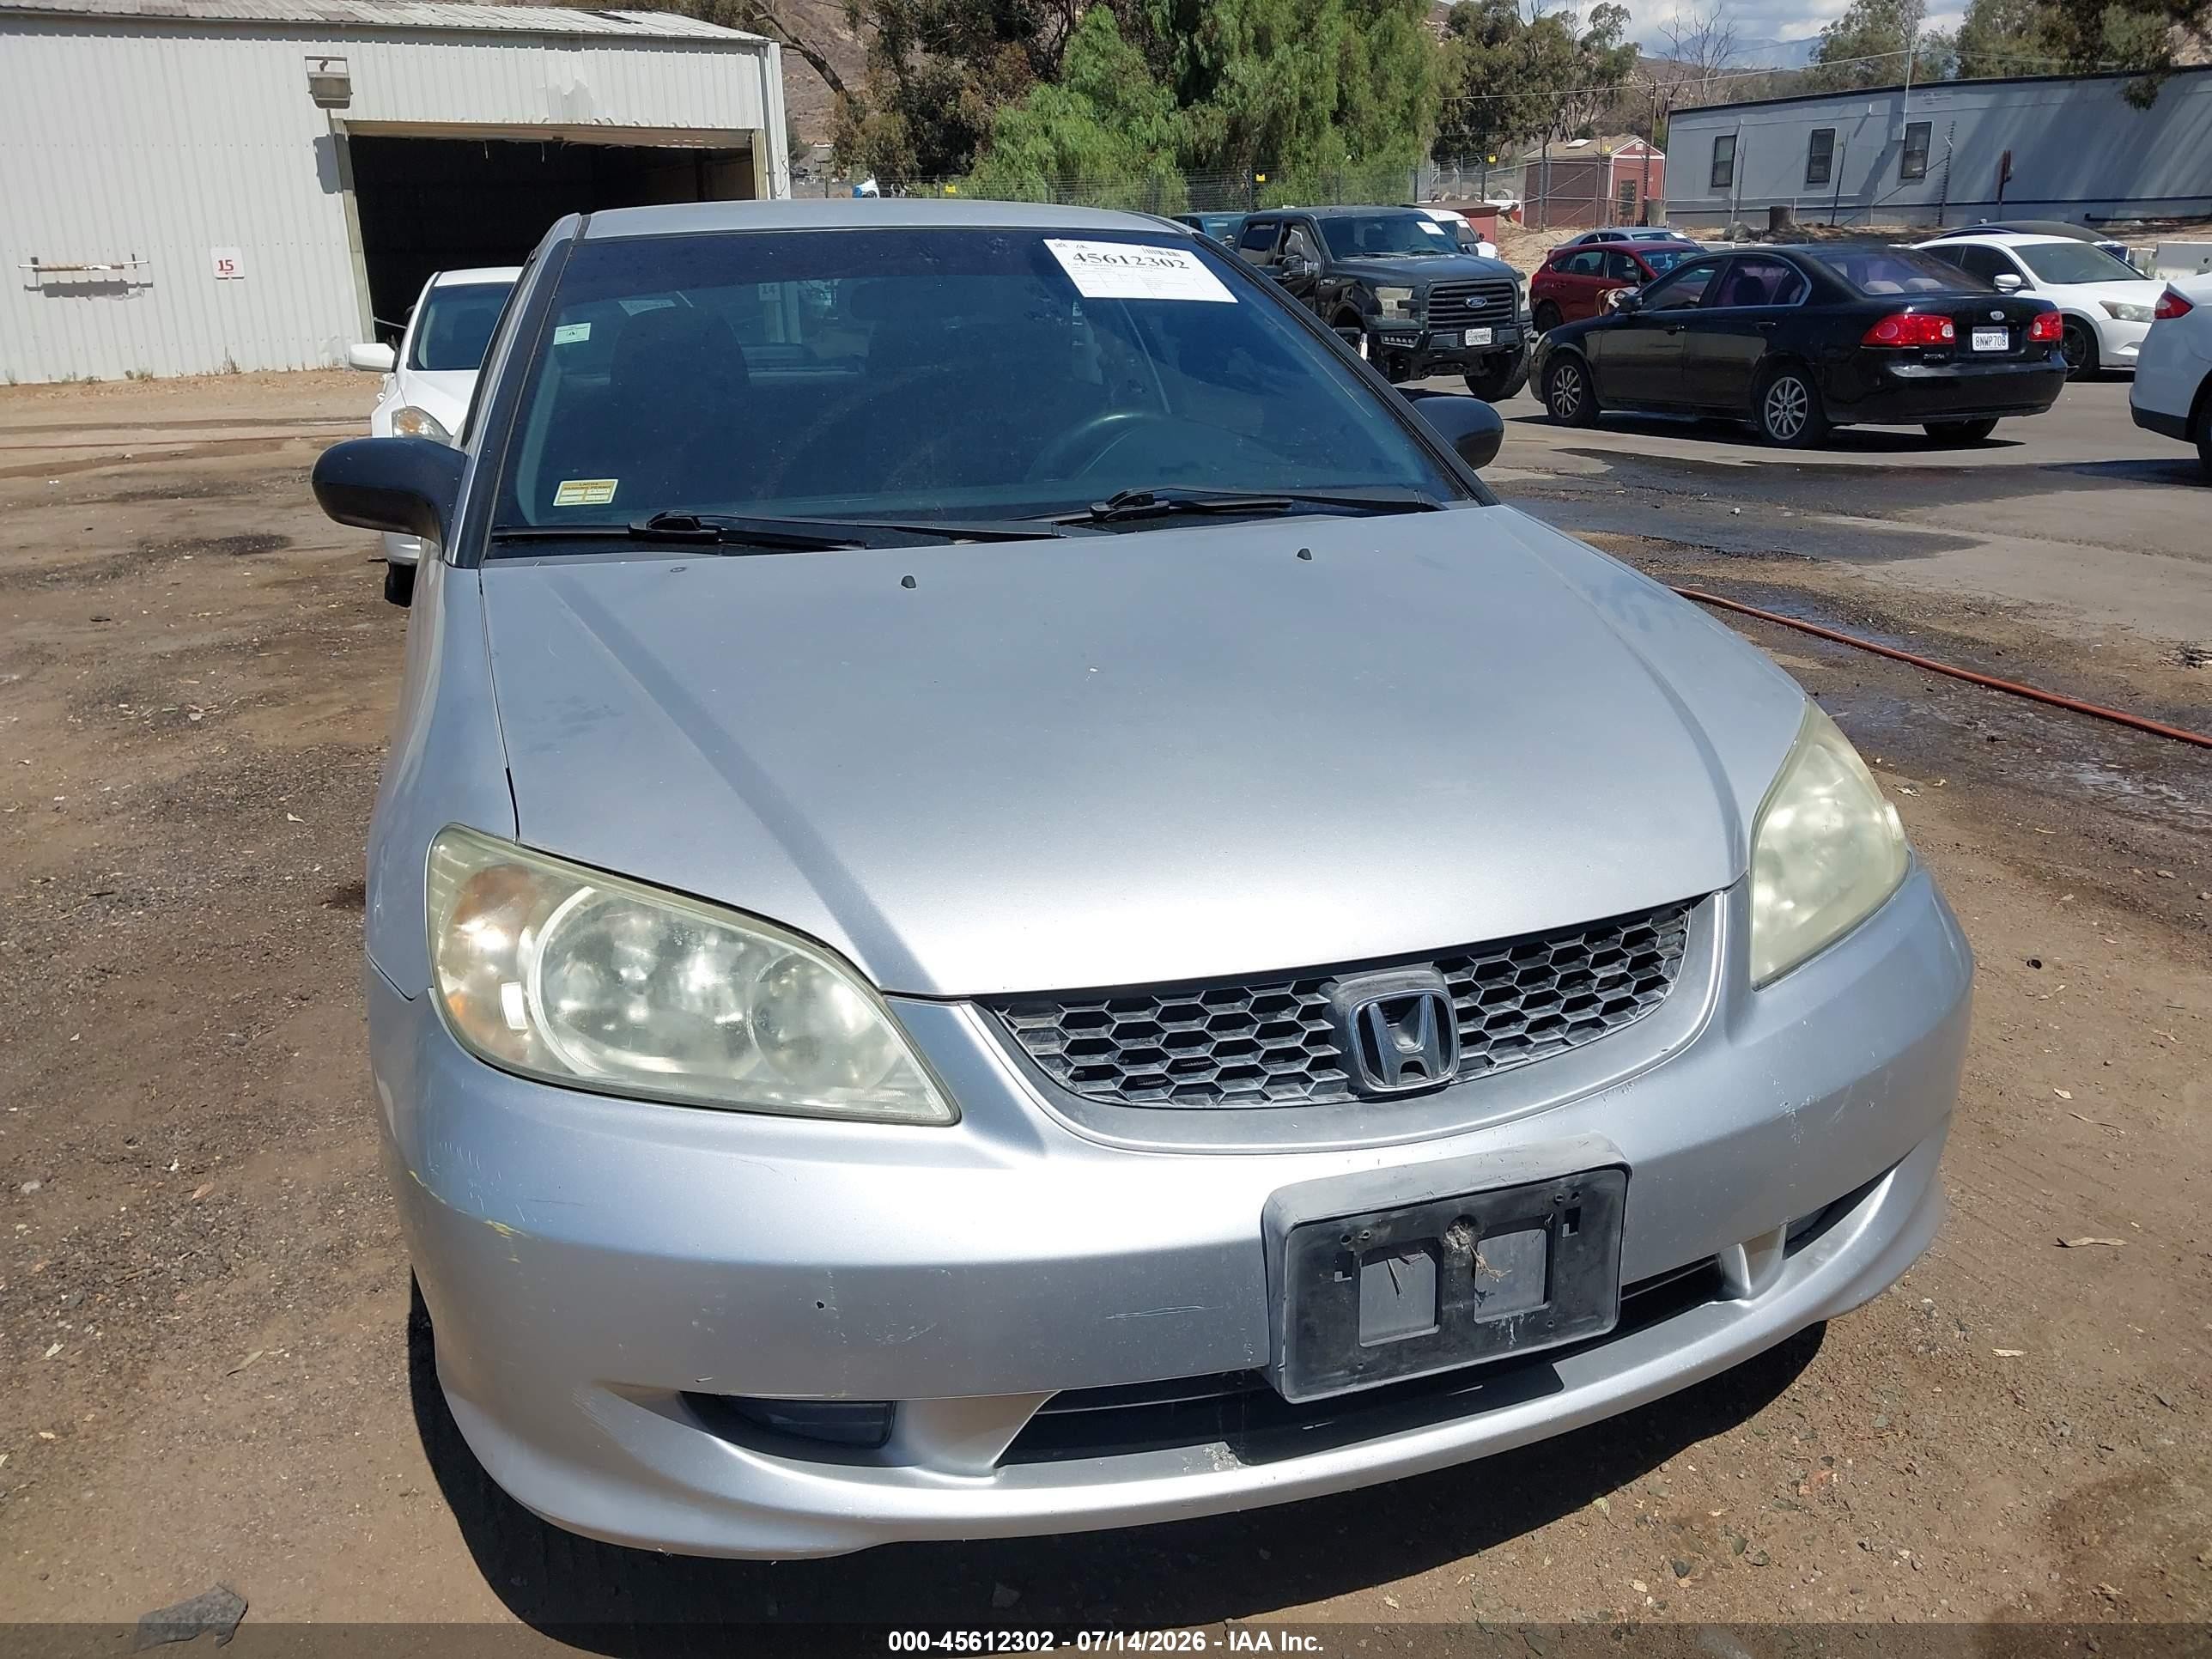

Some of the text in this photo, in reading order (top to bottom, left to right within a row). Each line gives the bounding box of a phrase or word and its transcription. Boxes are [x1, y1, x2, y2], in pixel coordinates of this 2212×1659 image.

[218, 259, 234, 271] 15
[1073, 252, 1191, 270] 45612302
[1975, 335, 2007, 347] 8NWP708
